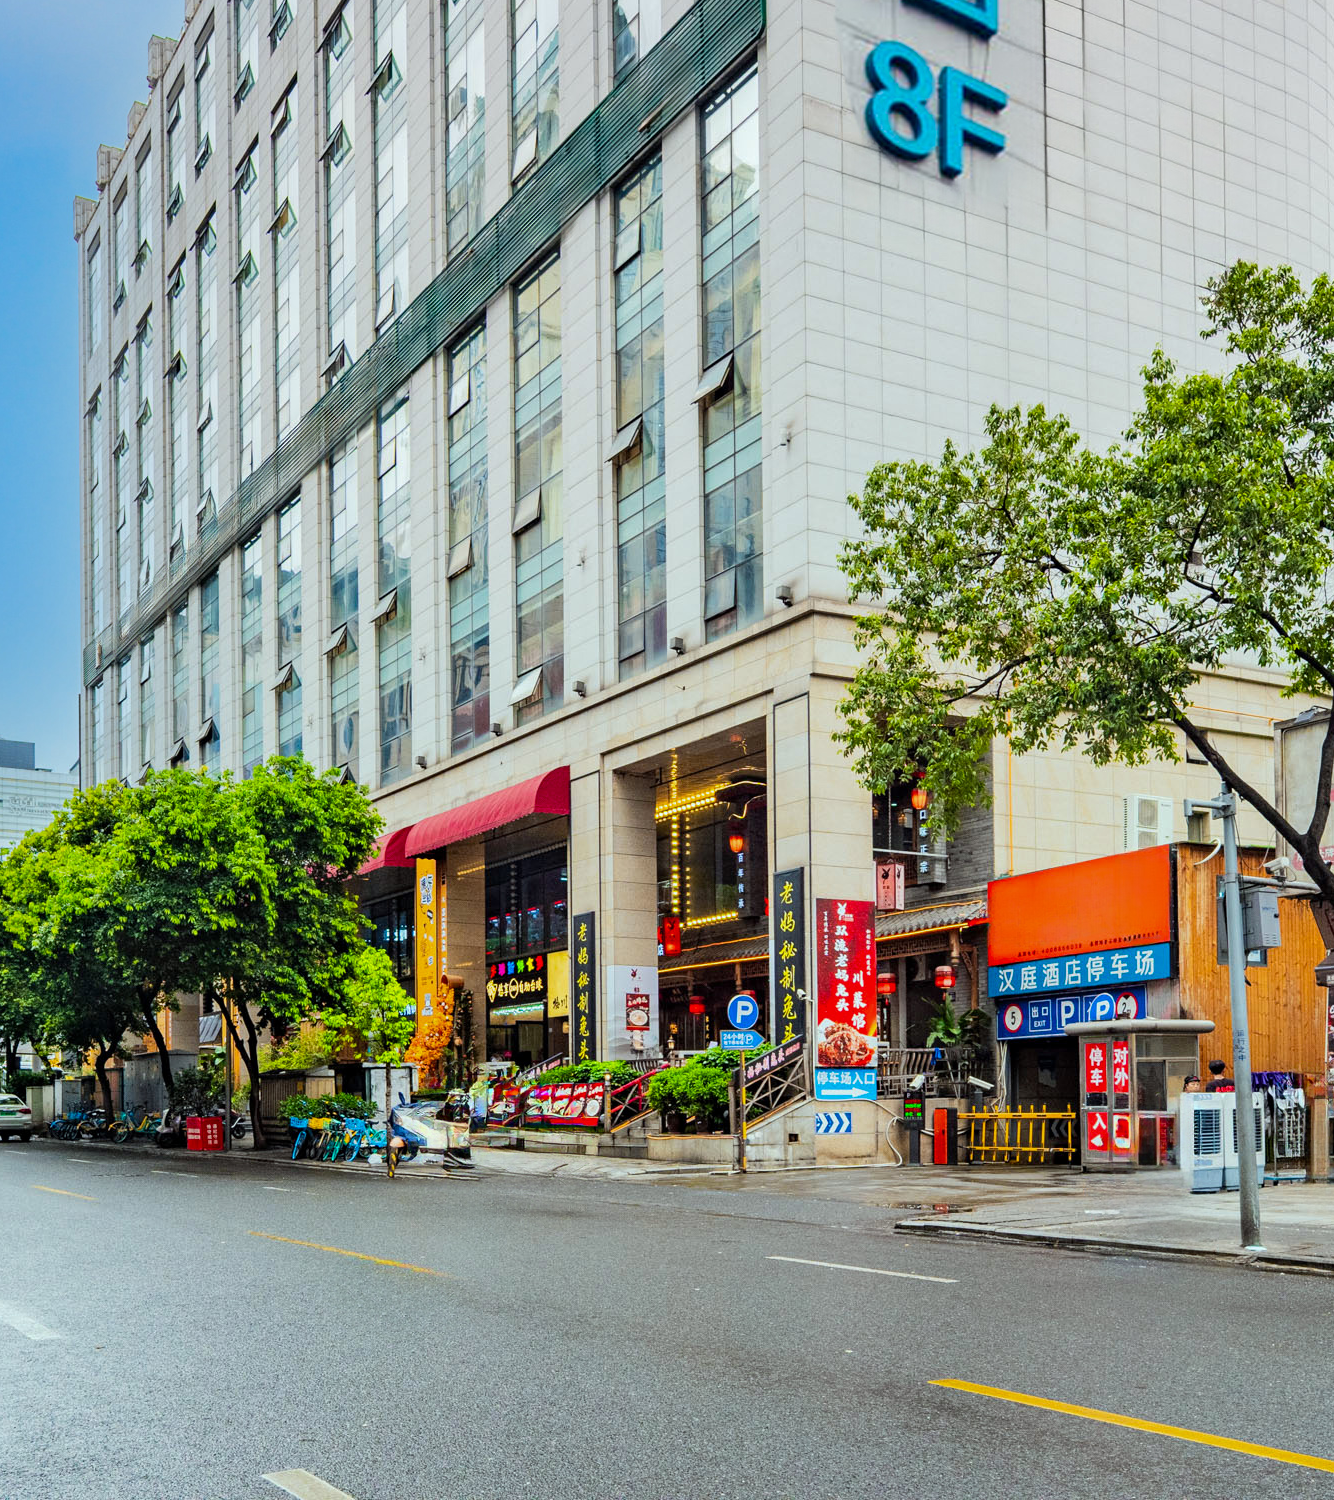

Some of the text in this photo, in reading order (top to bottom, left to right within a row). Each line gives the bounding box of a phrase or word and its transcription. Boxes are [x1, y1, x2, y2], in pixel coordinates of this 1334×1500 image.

[865, 39, 1008, 178] 8F
[779, 880, 797, 1045] 老妈秘制兔头
[834, 925, 849, 1012] 双流老妈兔头
[998, 950, 1155, 993] 汉庭酒店停车场
[576, 922, 590, 1060] 老妈秘制兔头
[852, 970, 867, 1030] 川菜馆
[736, 1000, 754, 1024] P
[1010, 1011, 1016, 1026] 5
[1031, 1006, 1049, 1018] 出口
[1033, 1019, 1046, 1028] EXIT
[1060, 1000, 1075, 1027] P
[1096, 1000, 1110, 1020] P
[723, 1033, 744, 1041] 24小时
[816, 1071, 876, 1085] 停车场入口
[1088, 1046, 1103, 1087] 停车
[1113, 1046, 1129, 1087] 对外
[1092, 1113, 1107, 1130] 入
